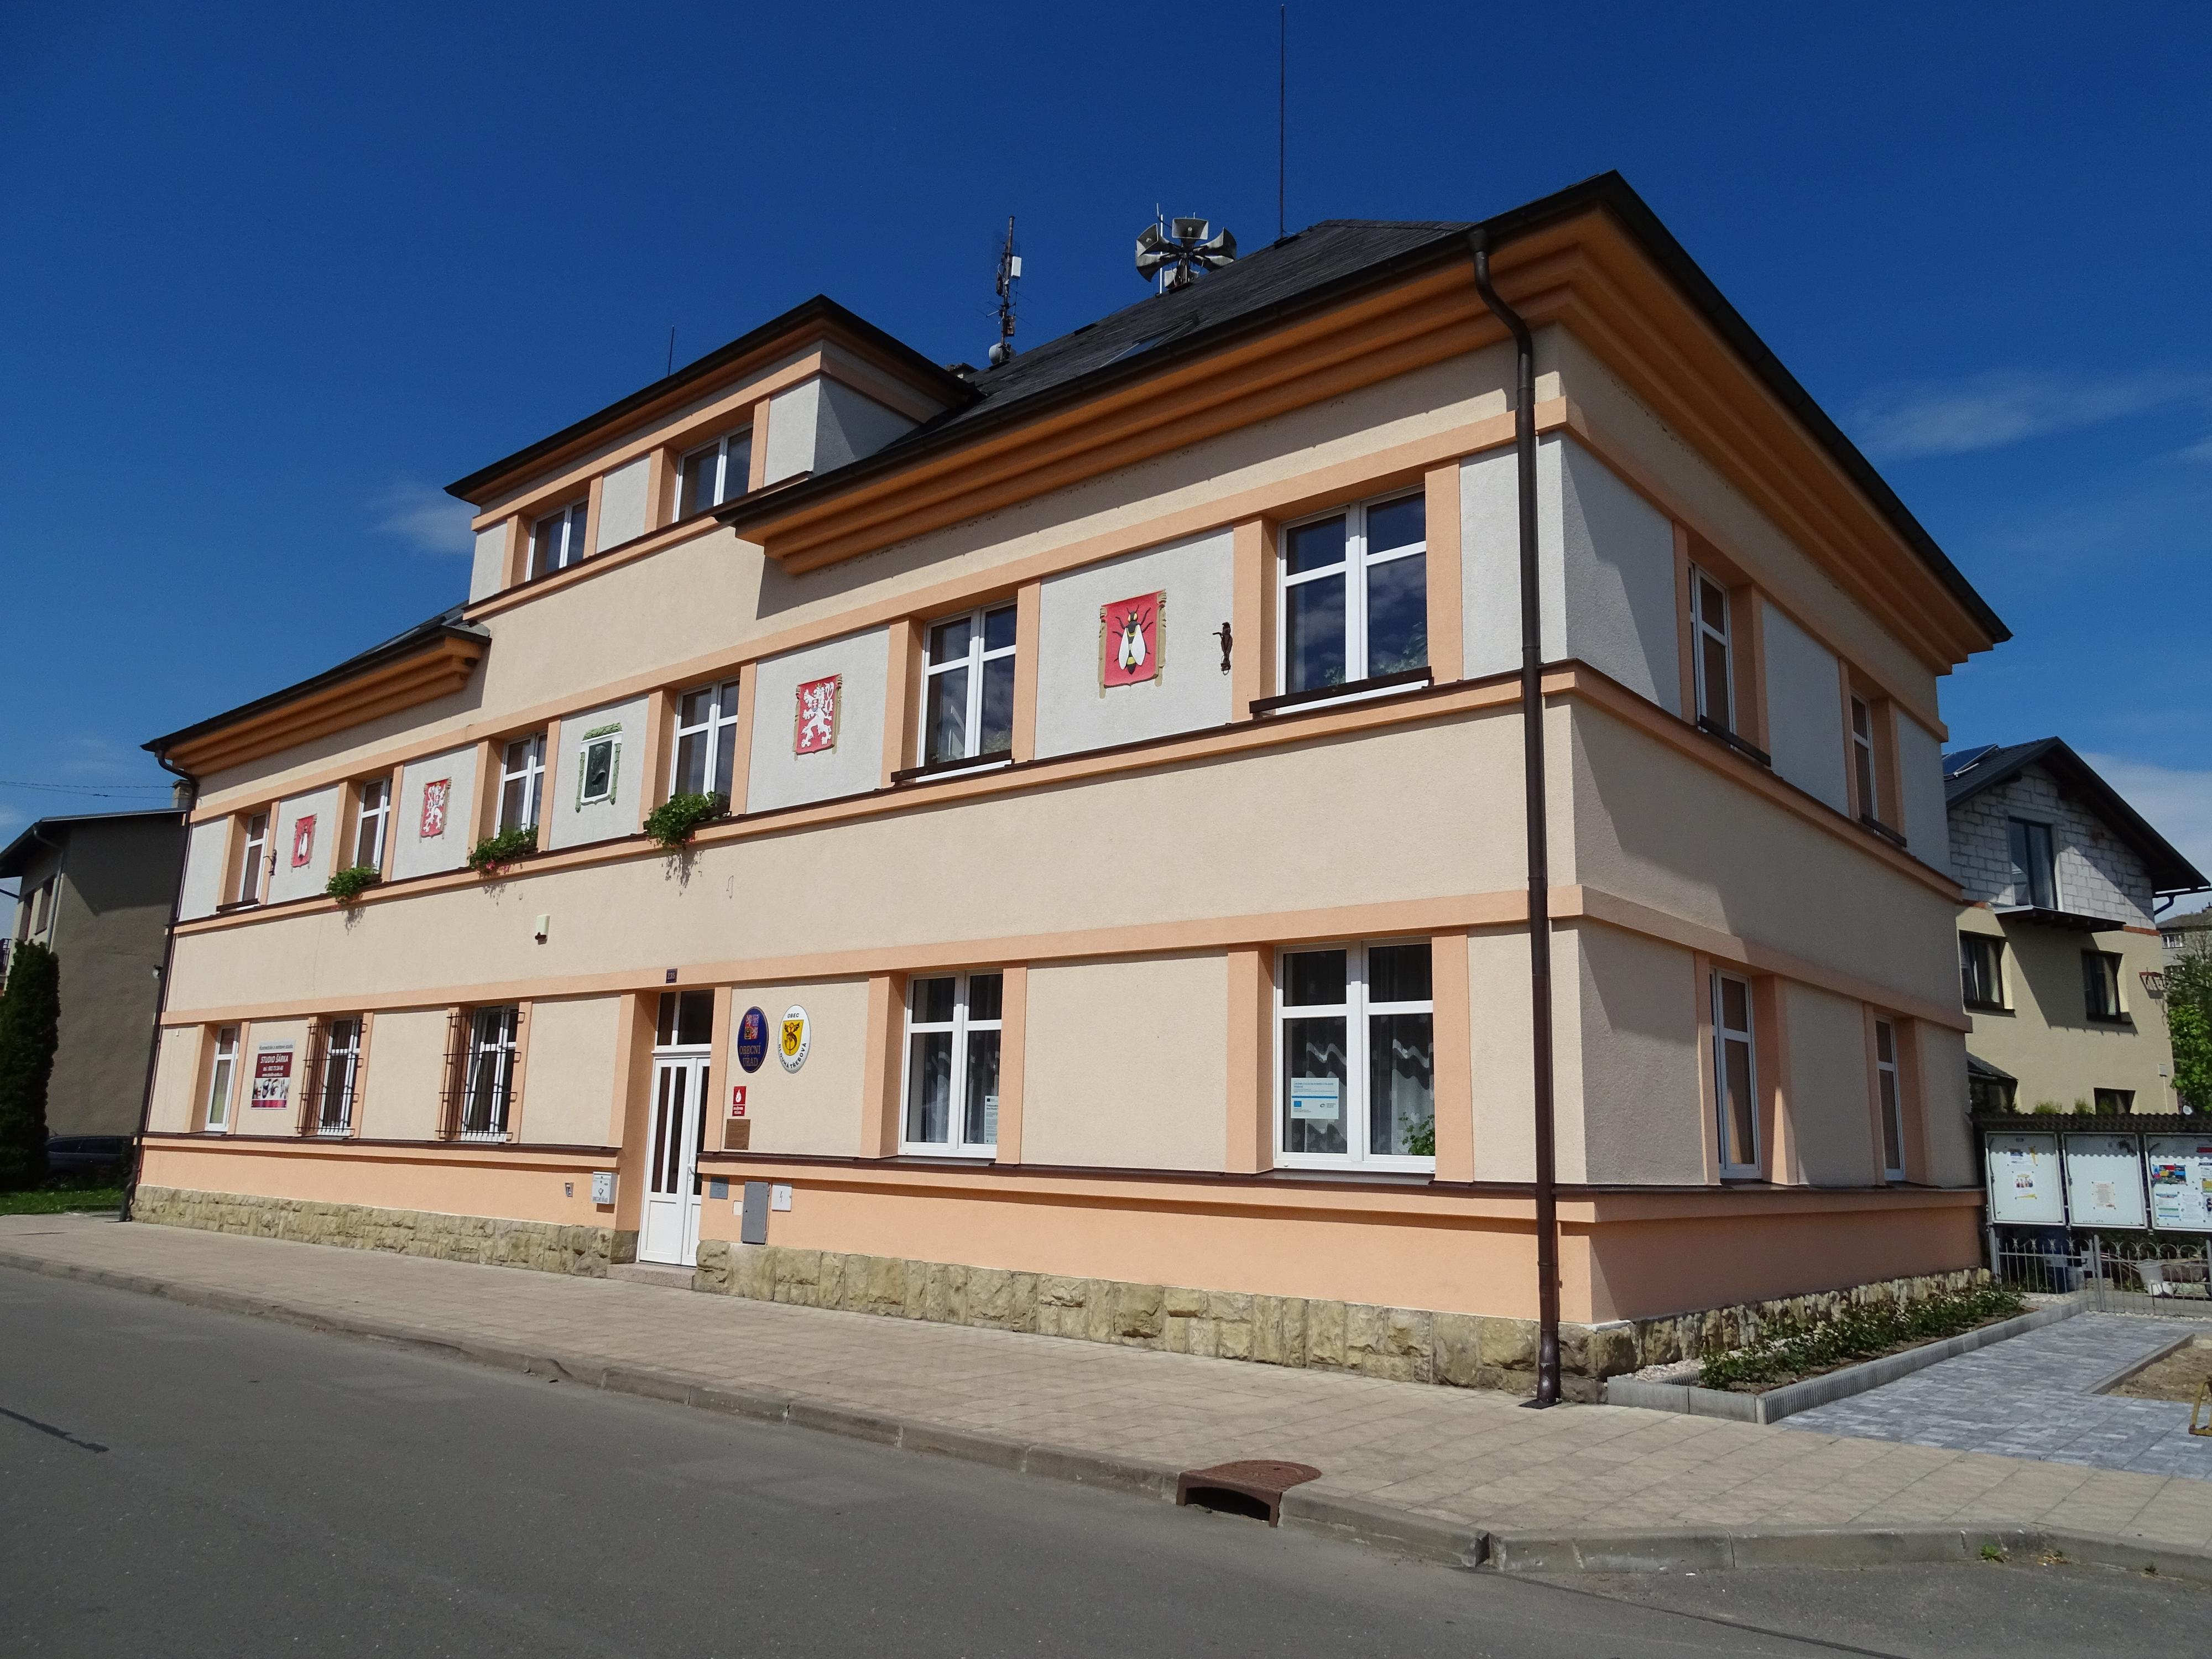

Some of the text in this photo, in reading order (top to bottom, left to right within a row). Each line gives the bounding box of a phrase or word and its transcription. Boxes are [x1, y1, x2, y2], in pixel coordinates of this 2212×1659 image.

[739, 1042, 761, 1055] OBECNÍ
[275, 1054, 289, 1063] ŠÁRKA
[743, 1055, 758, 1066] ÚŘAD
[790, 1042, 807, 1068] TŘEBOVÁ
